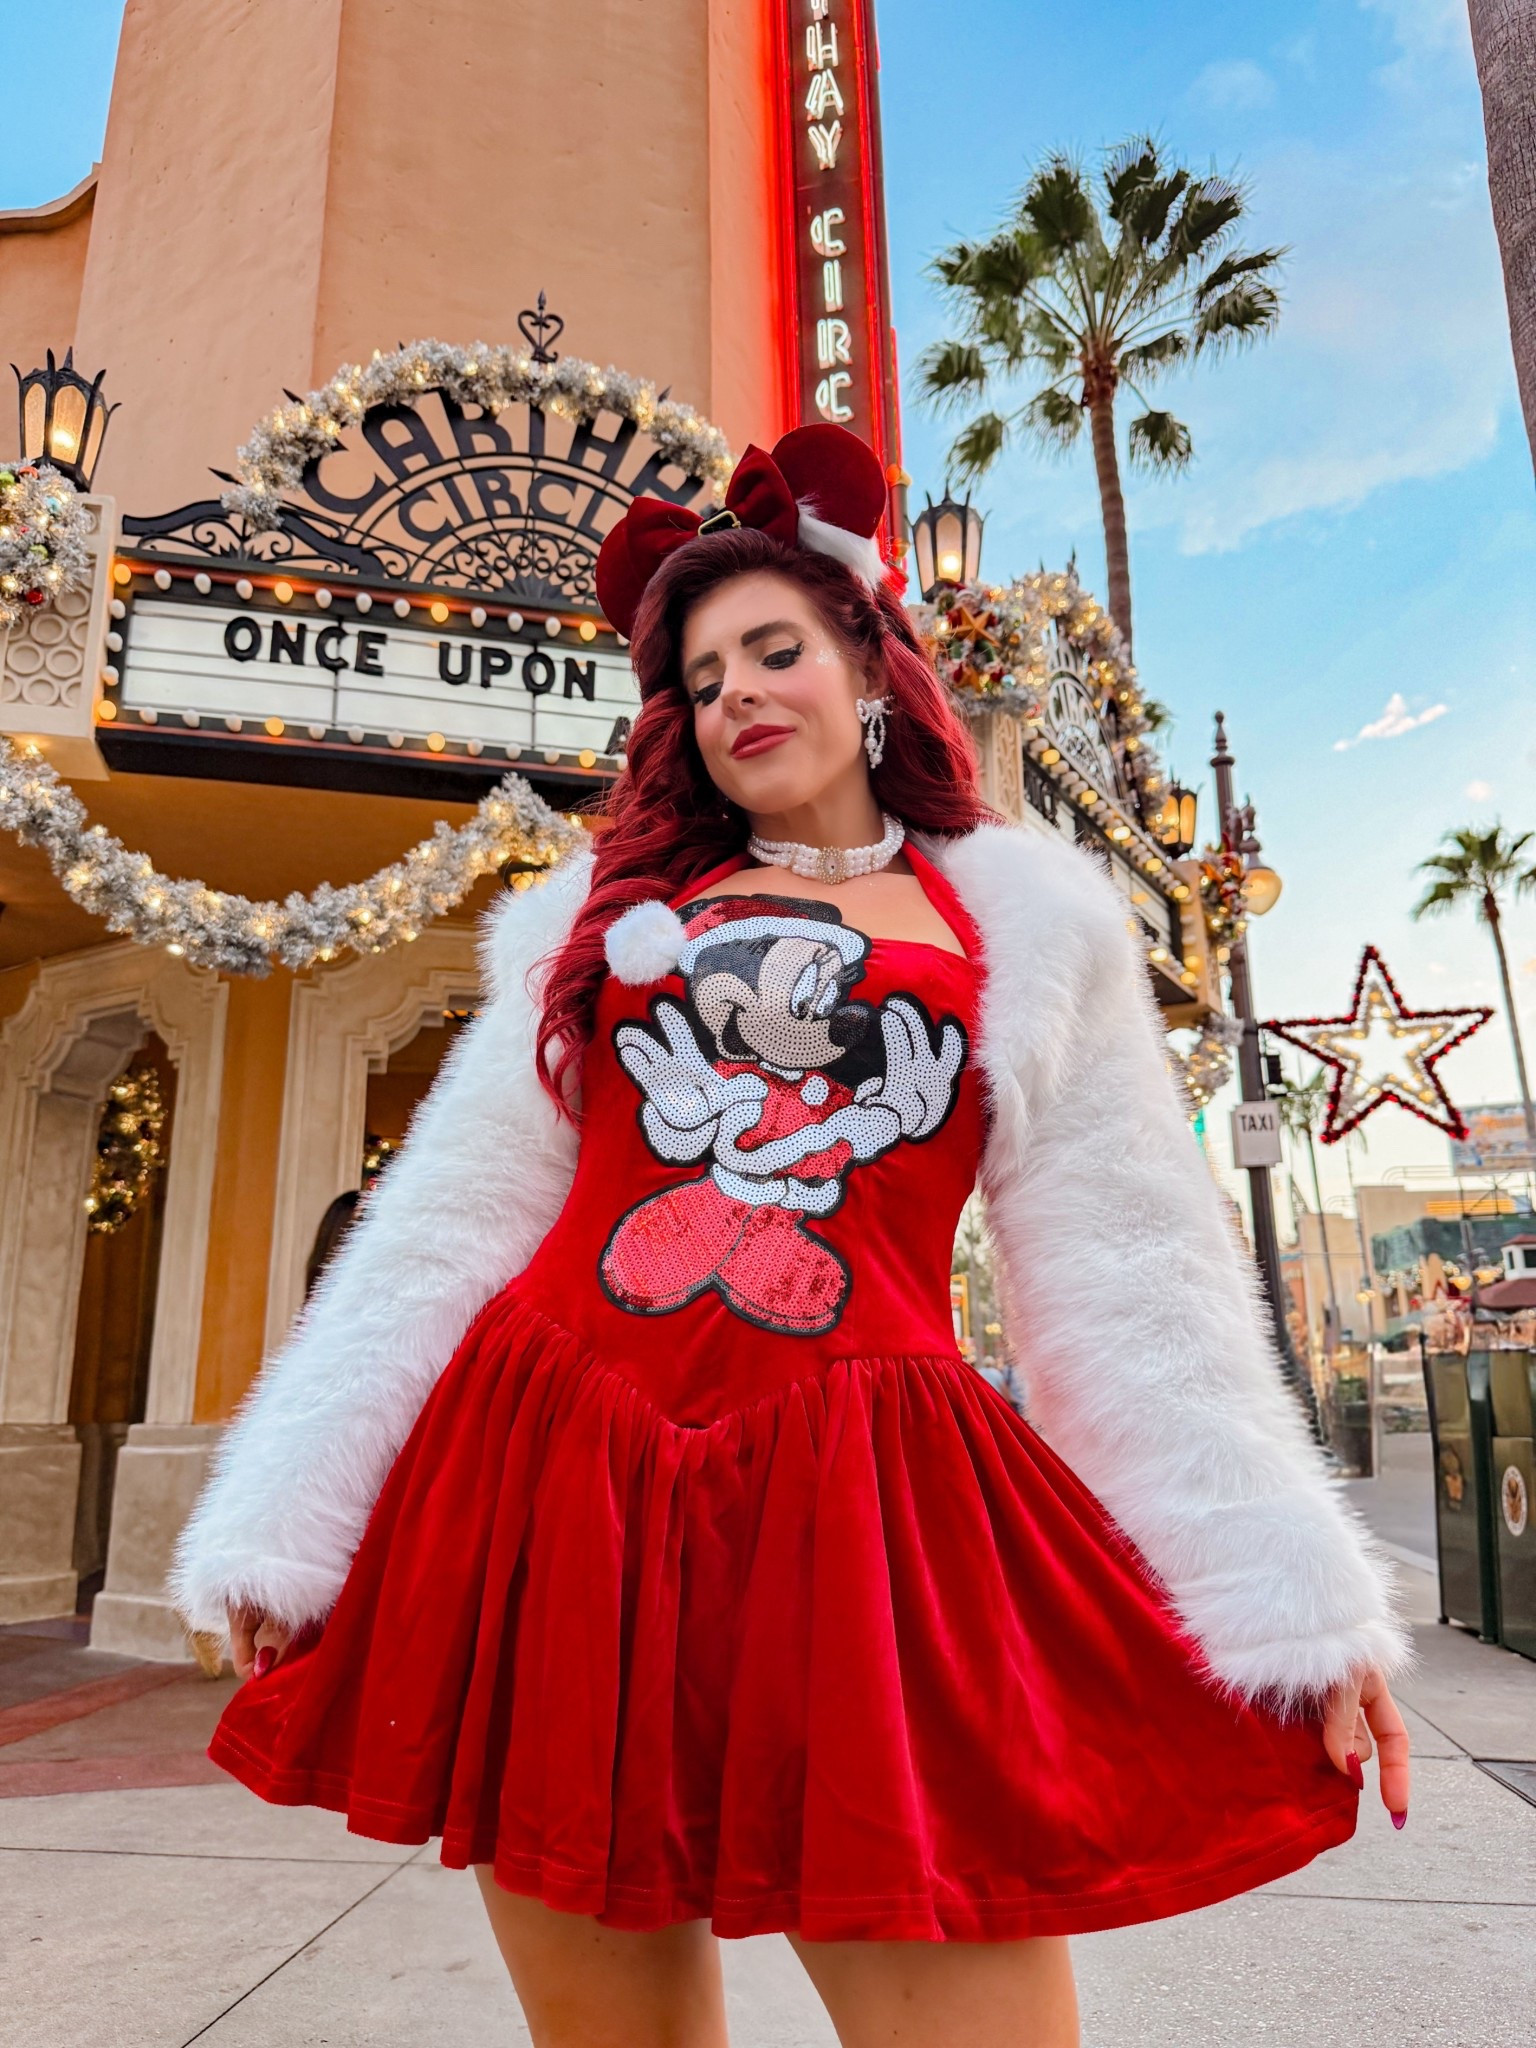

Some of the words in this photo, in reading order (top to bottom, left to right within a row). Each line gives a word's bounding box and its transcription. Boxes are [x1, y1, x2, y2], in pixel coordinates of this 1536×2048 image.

[224, 616, 388, 676] ONCE
[438, 641, 597, 701] UPON
[1239, 1114, 1273, 1131] TAXI
